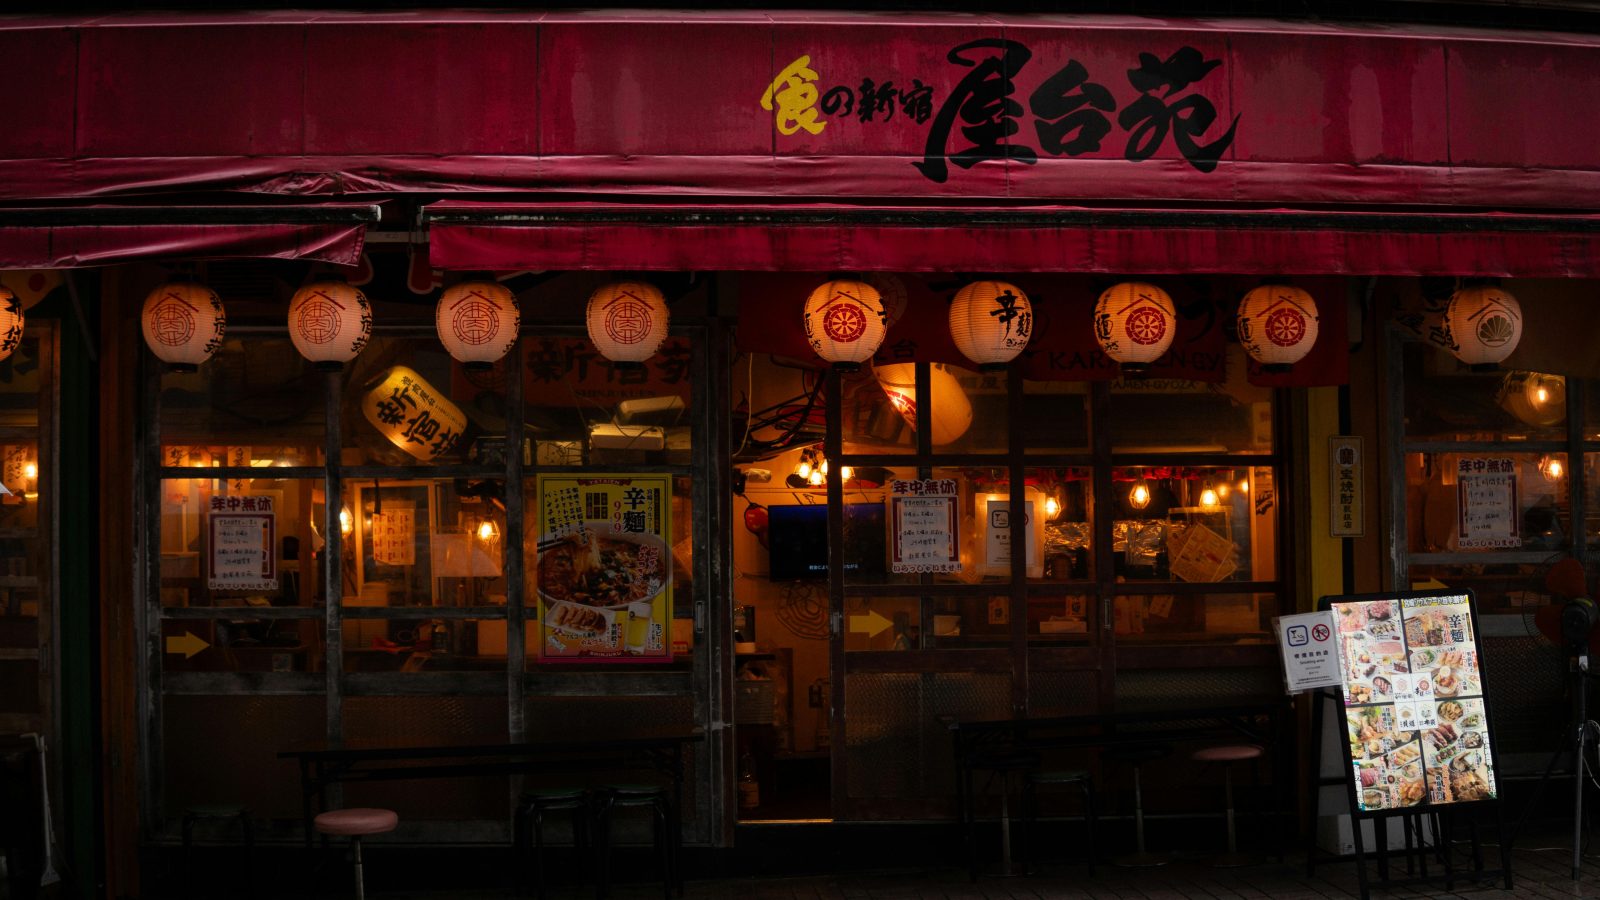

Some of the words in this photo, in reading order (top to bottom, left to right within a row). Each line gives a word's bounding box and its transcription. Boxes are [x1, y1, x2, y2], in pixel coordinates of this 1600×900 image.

[1459, 459, 1514, 473] 年中無休
[893, 480, 955, 495] 年中無休
[211, 496, 272, 512] 年中無休
